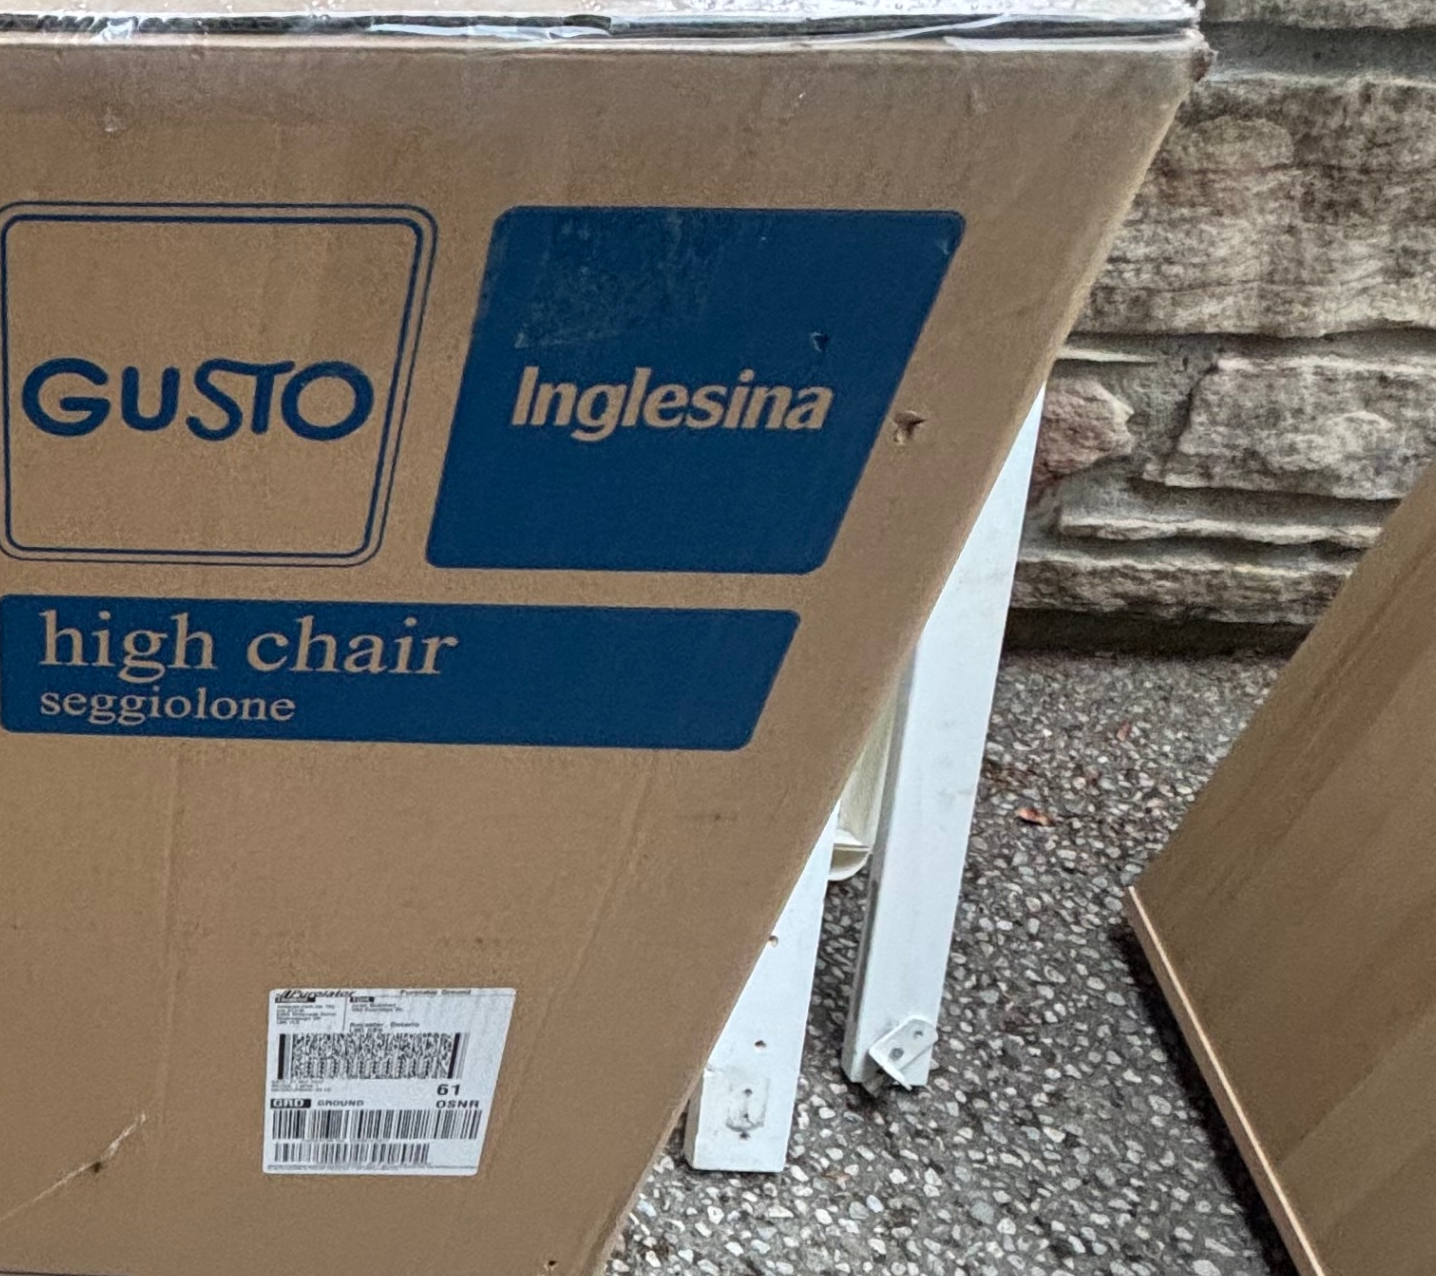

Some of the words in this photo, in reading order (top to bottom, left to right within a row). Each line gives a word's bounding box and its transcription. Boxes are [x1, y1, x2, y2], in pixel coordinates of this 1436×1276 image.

[20, 357, 375, 442] GUSTO
[510, 366, 833, 442] Inglesina
[38, 610, 215, 683] high
[246, 616, 460, 676] chair
[39, 686, 296, 725] seggiolone
[317, 1099, 364, 1107] GROUND
[437, 1083, 460, 1096] 61
